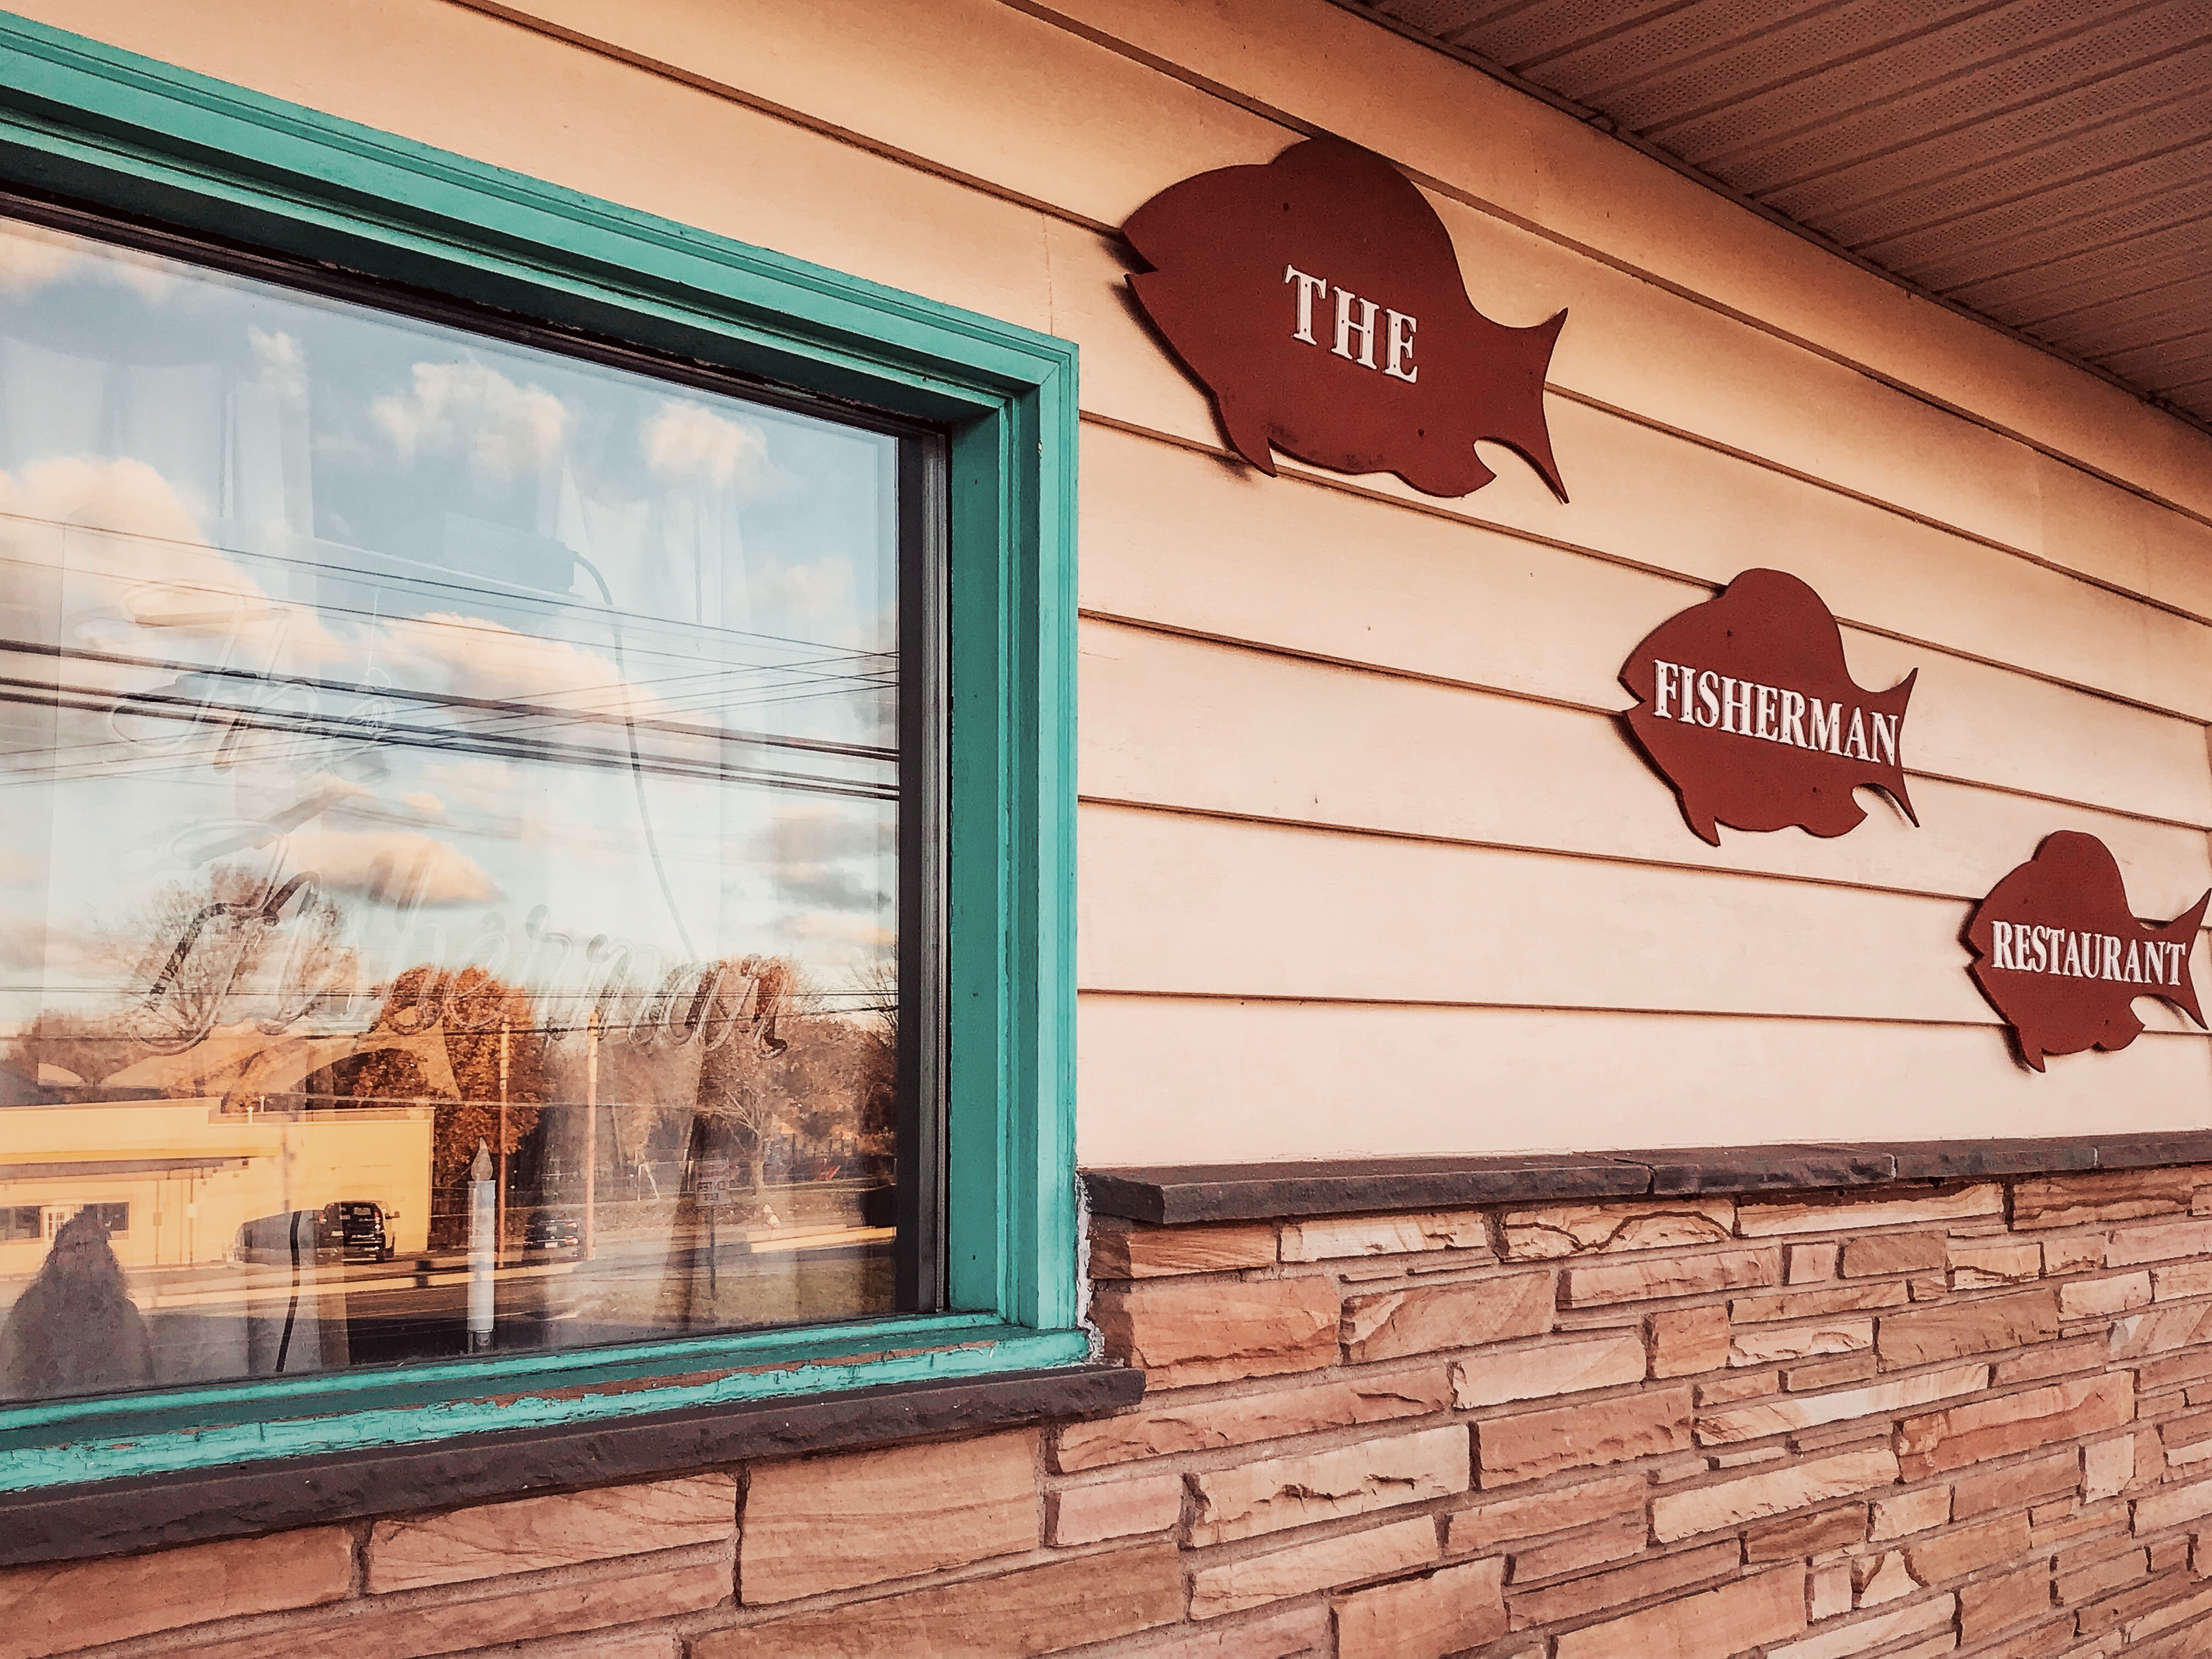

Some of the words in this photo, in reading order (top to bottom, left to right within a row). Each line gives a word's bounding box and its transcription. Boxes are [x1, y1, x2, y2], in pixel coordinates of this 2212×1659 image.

[1284, 264, 1418, 383] THE
[1653, 659, 1898, 766] FISHERMAN
[1991, 921, 2186, 985] RESTAURANT
